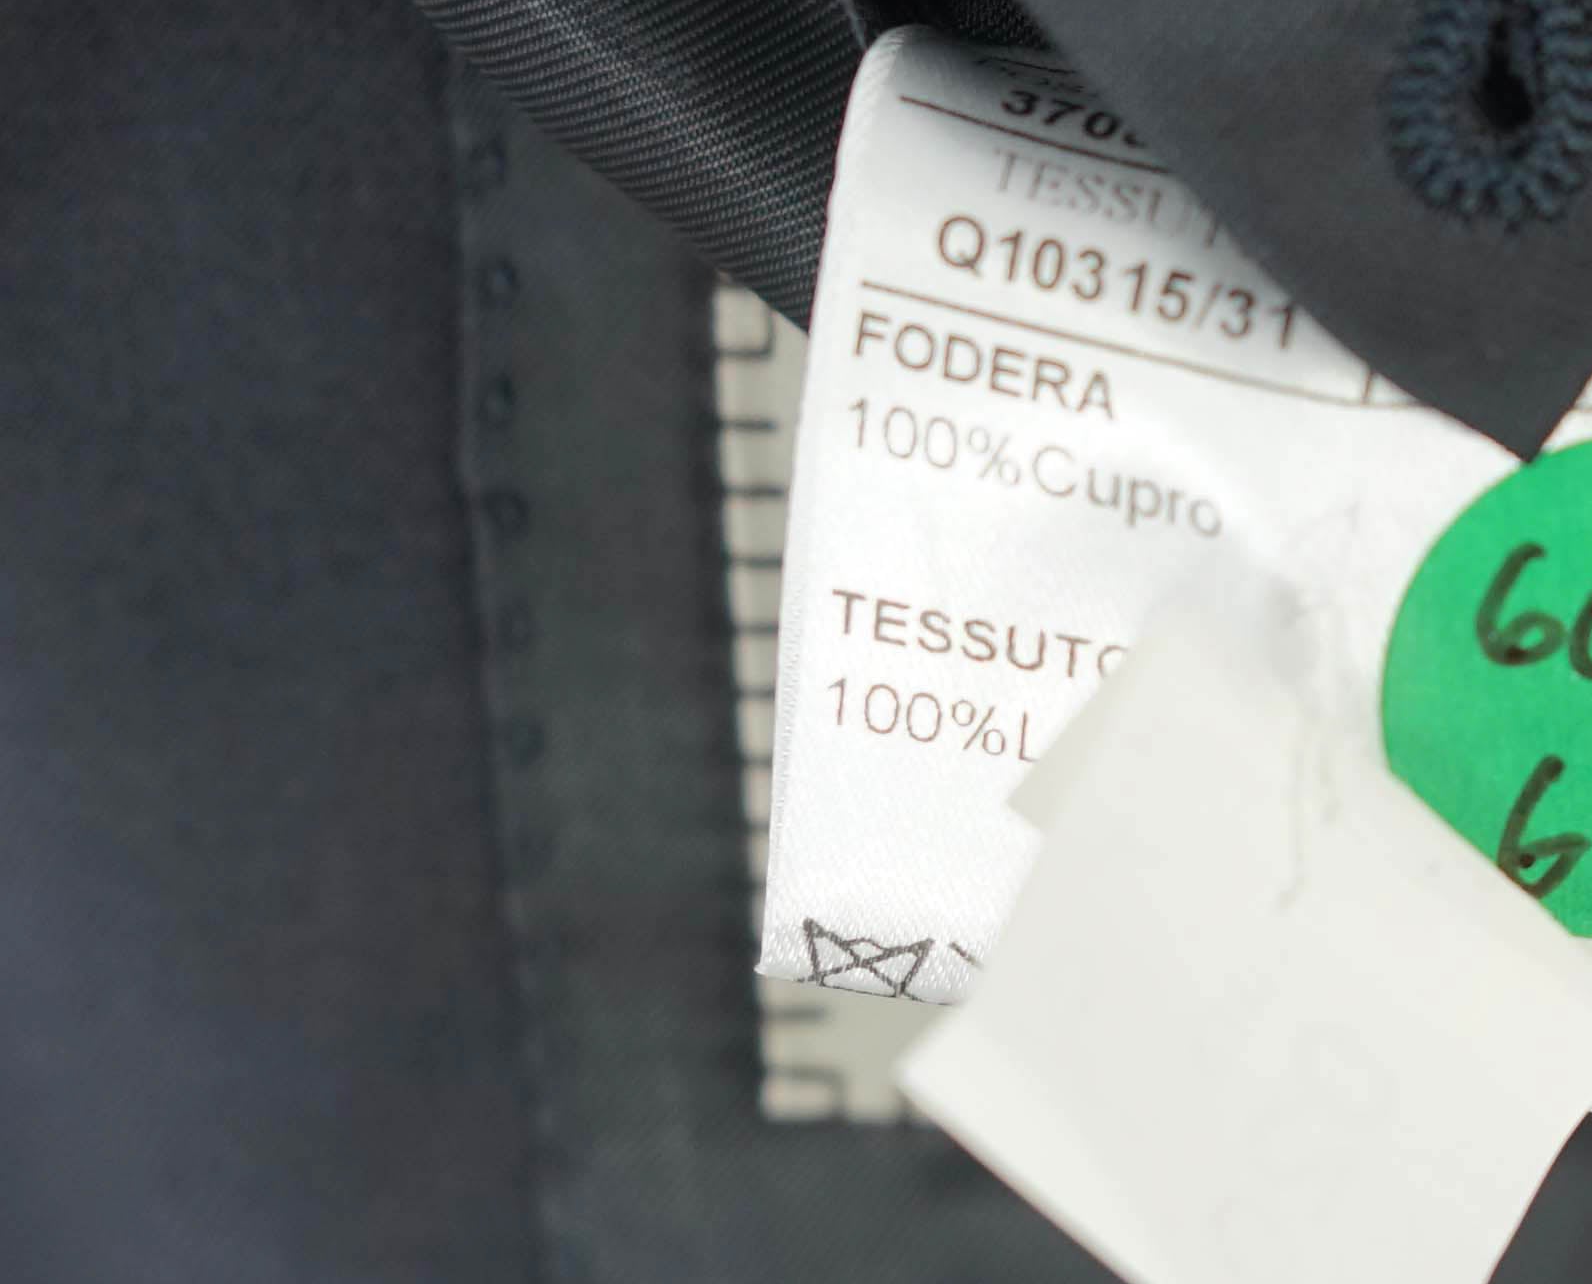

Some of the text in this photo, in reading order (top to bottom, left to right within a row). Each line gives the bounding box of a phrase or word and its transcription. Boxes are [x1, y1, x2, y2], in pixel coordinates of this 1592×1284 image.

[1001, 89, 1147, 148] 370
[938, 215, 1298, 349] Q10315/31
[853, 311, 1116, 419] FODERA
